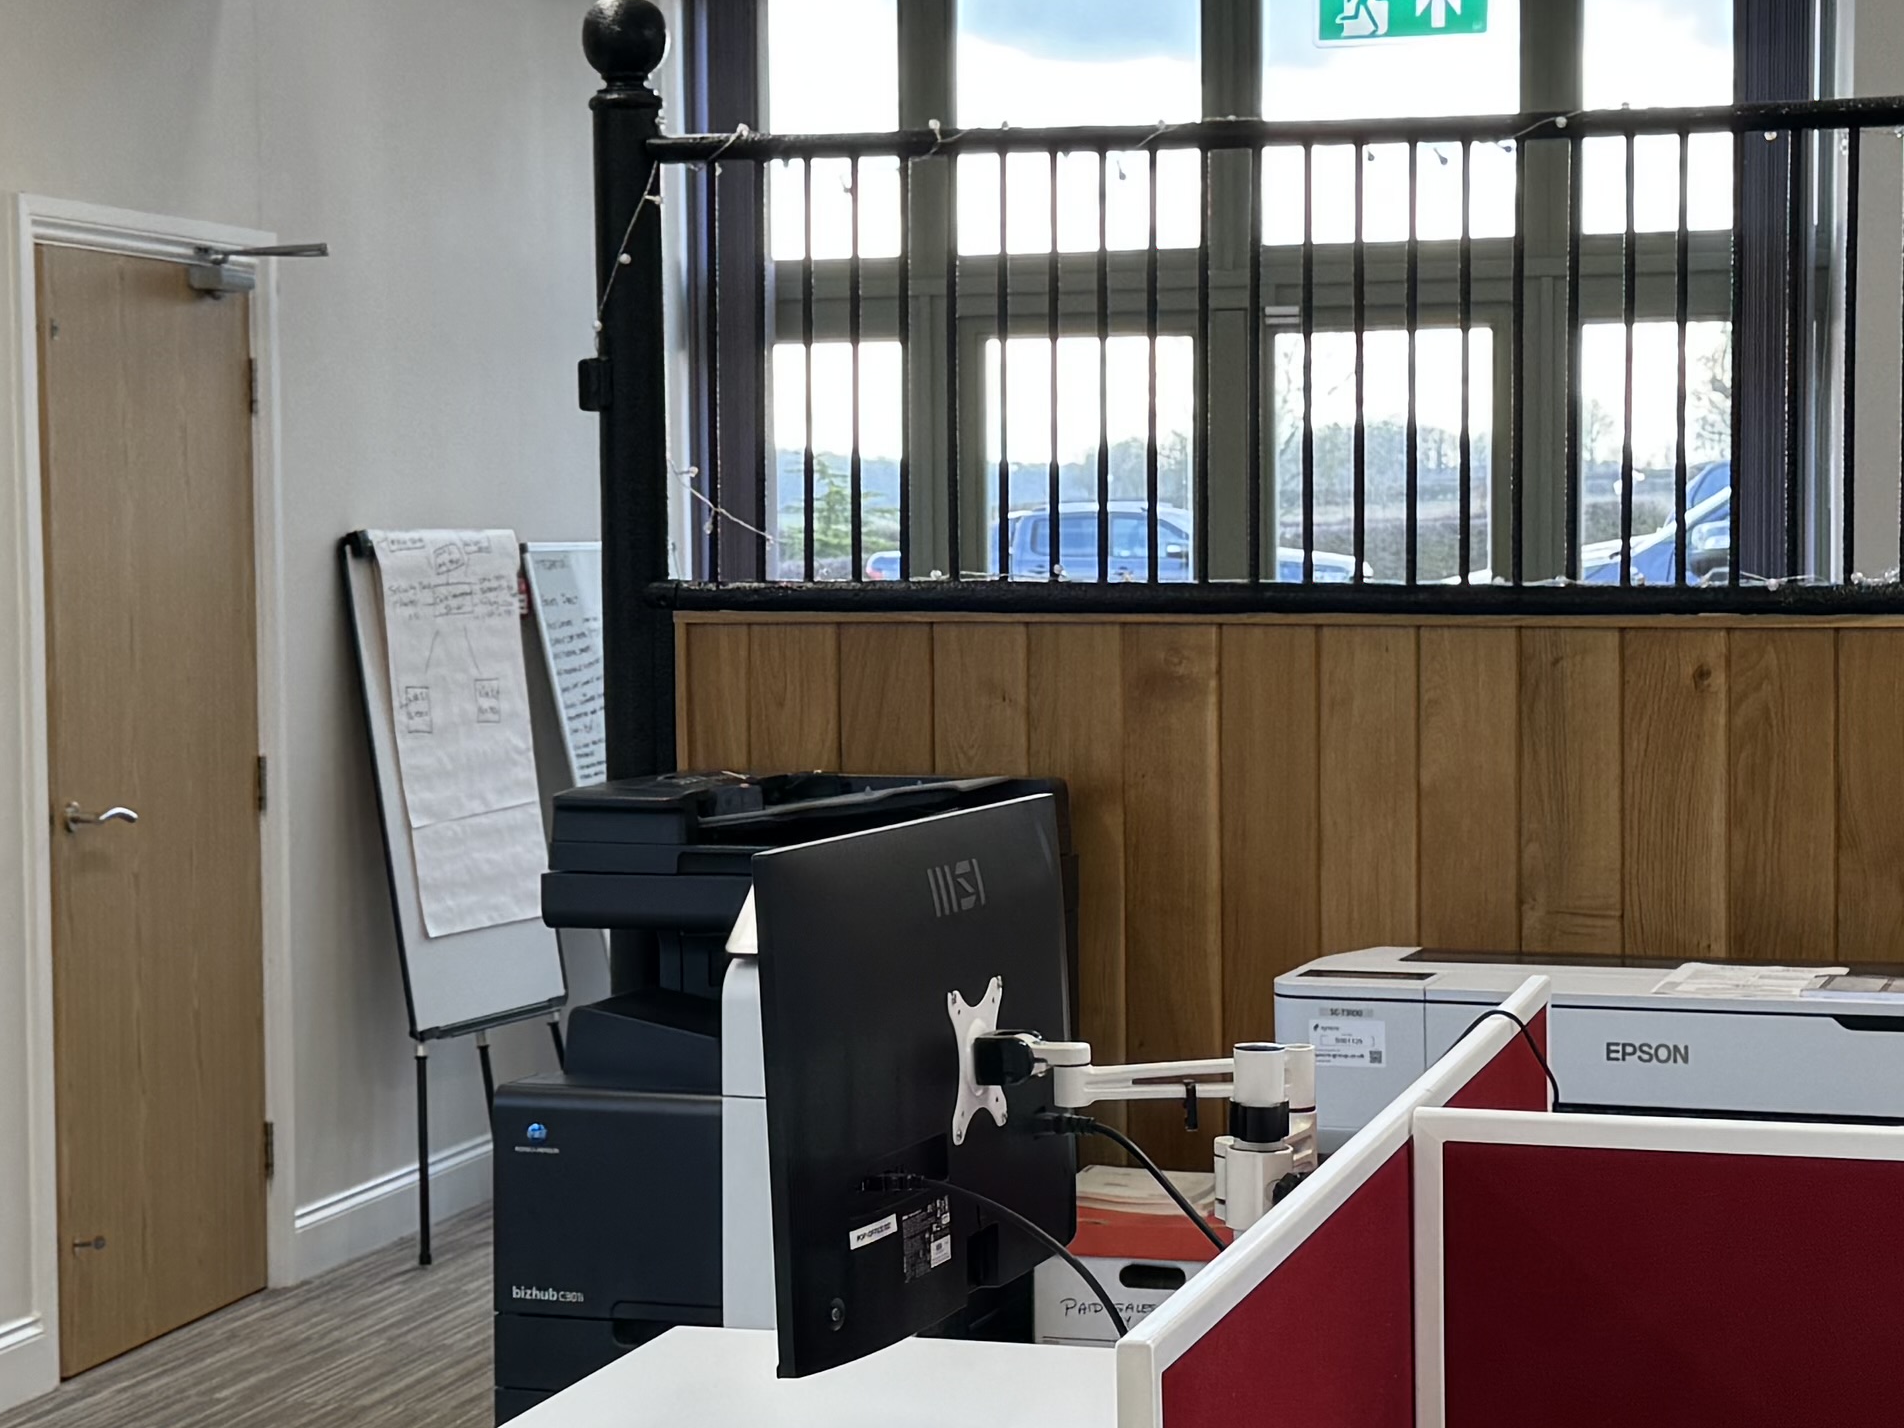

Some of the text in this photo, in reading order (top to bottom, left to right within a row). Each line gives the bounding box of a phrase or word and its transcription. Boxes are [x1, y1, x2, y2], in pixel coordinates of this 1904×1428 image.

[927, 858, 985, 918] MSI
[1606, 1042, 1689, 1064] EPSON
[512, 1285, 557, 1301] bizhub
